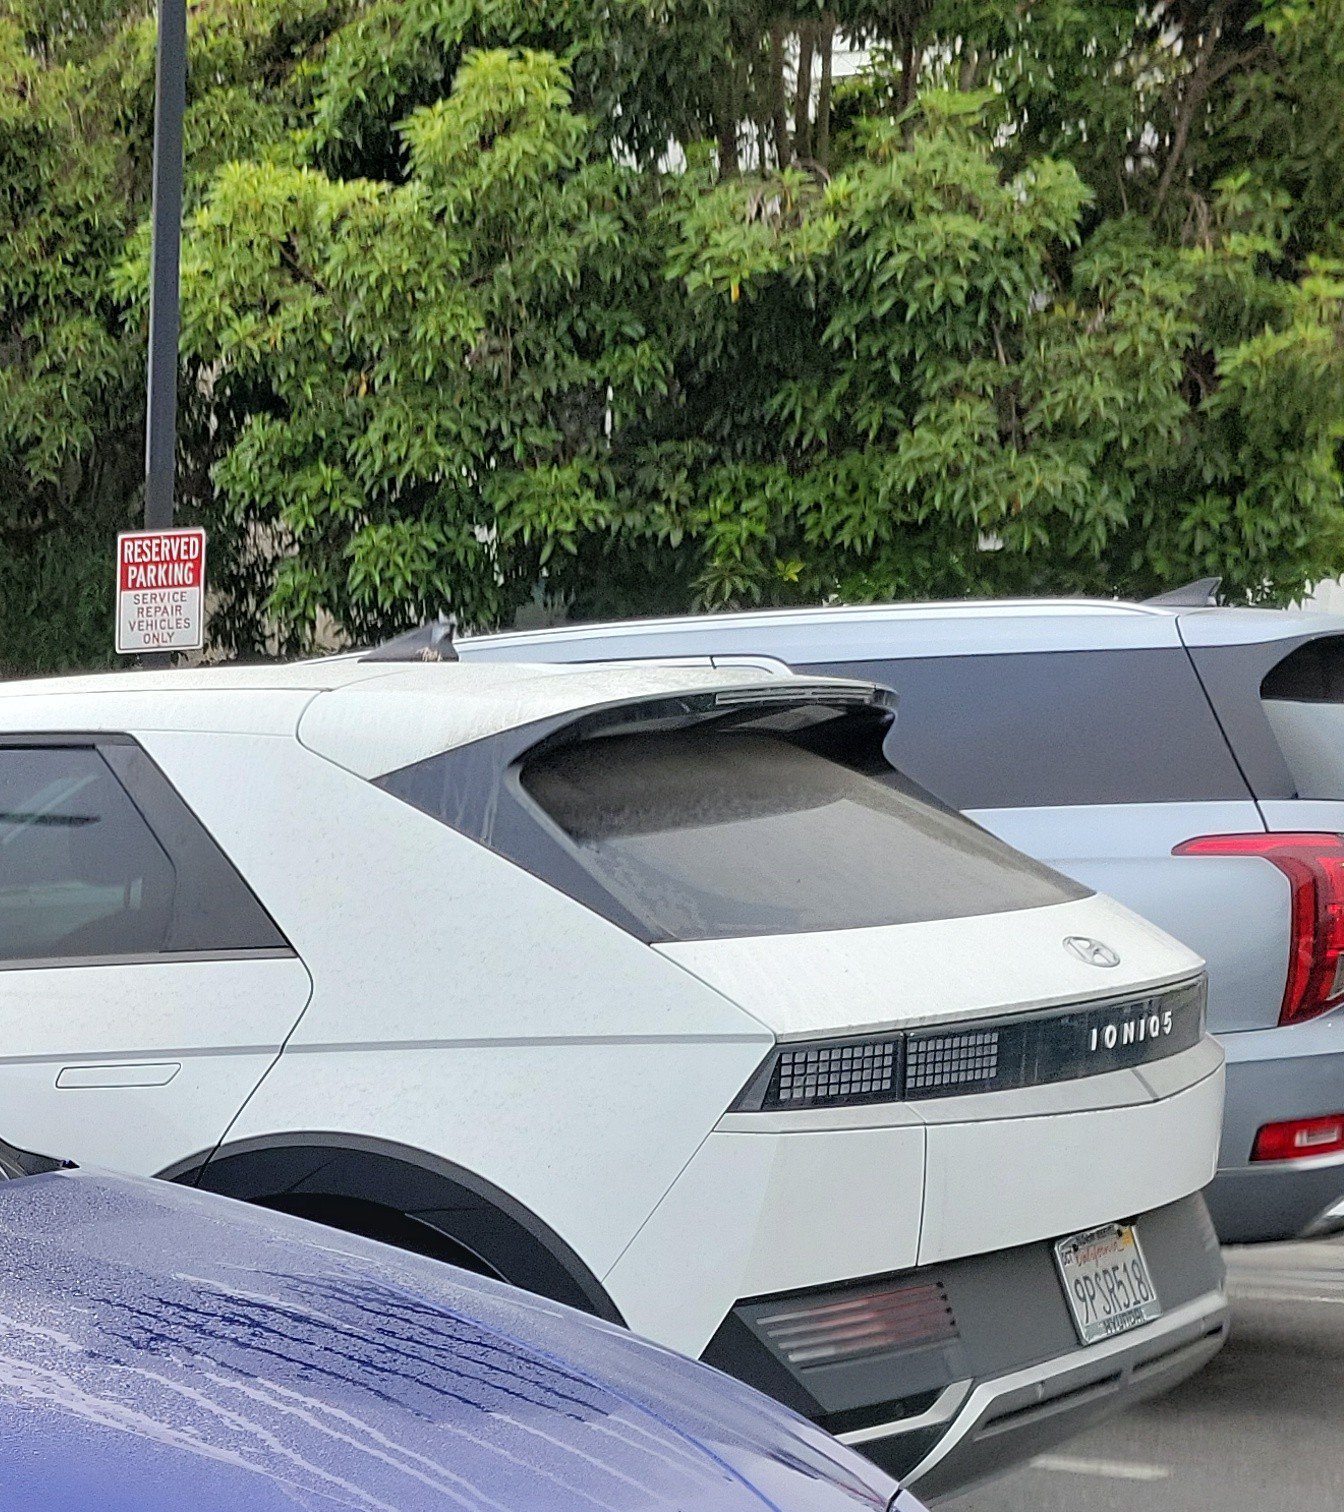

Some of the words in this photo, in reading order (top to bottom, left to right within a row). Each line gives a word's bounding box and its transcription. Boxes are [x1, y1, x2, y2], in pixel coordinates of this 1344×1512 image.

[124, 536, 199, 563] RESERVED
[128, 562, 194, 588] PARKING
[133, 591, 187, 605] SERVICE
[137, 605, 182, 618] REPAIR
[128, 617, 191, 631] VEHICLES
[143, 631, 175, 645] ONLY
[1074, 1259, 1150, 1324] 9PSR518
